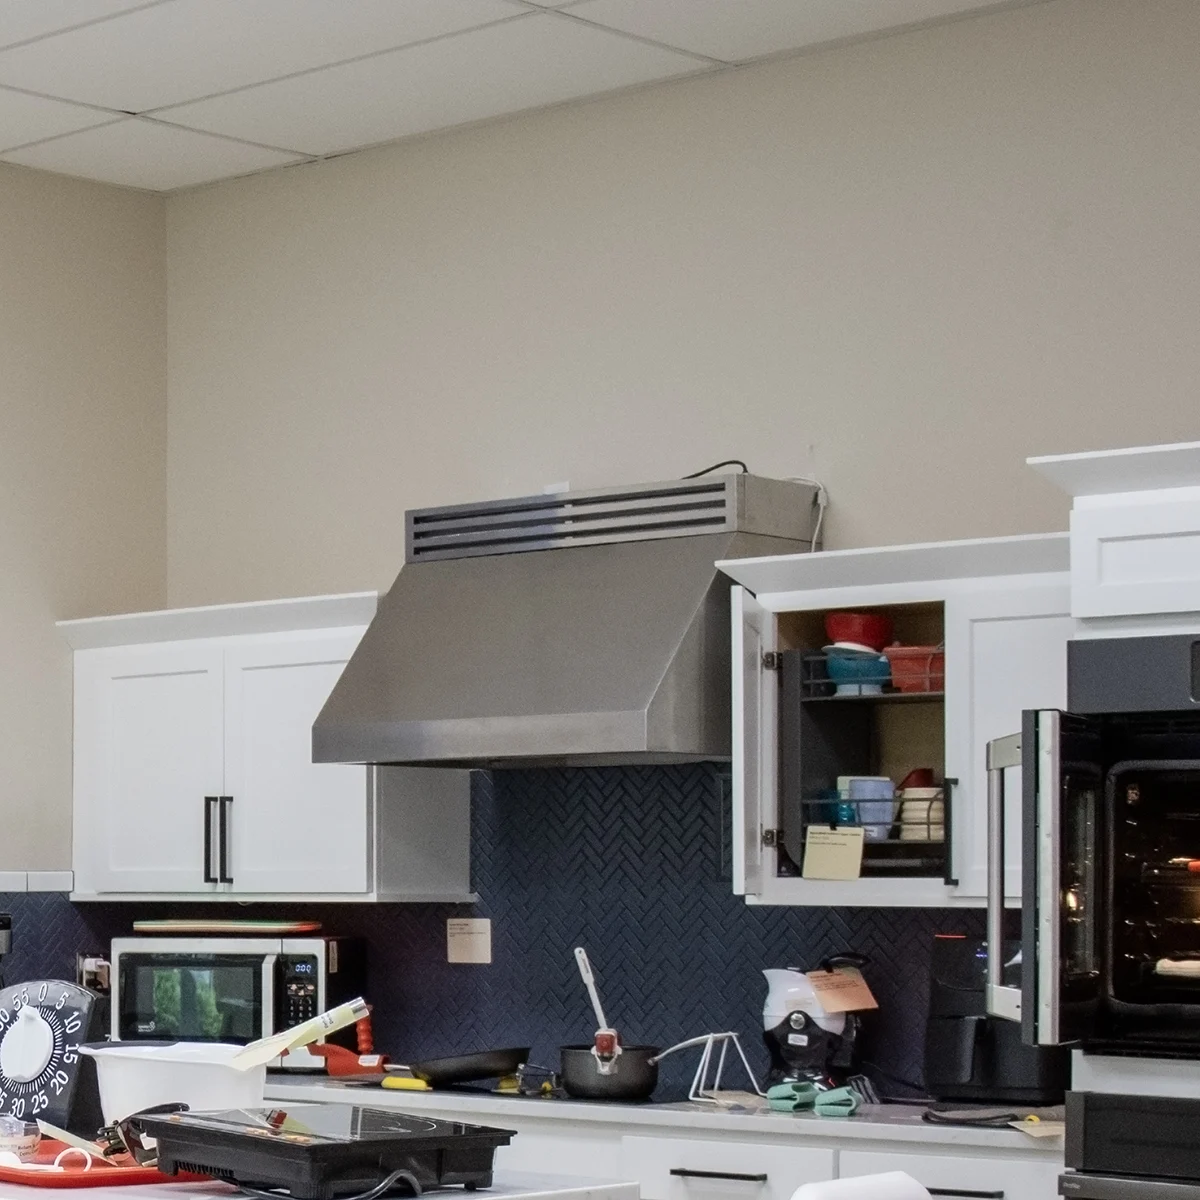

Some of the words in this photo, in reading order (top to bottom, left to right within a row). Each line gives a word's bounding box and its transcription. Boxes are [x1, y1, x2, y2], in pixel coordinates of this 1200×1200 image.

[12, 987, 30, 1011] 55
[38, 982, 48, 1002] 0
[55, 991, 70, 1010] 5
[64, 1011, 81, 1034] 10
[63, 1043, 80, 1064] 15
[50, 1070, 69, 1095] 20
[8, 1097, 25, 1118] 30
[31, 1090, 49, 1115] 25
